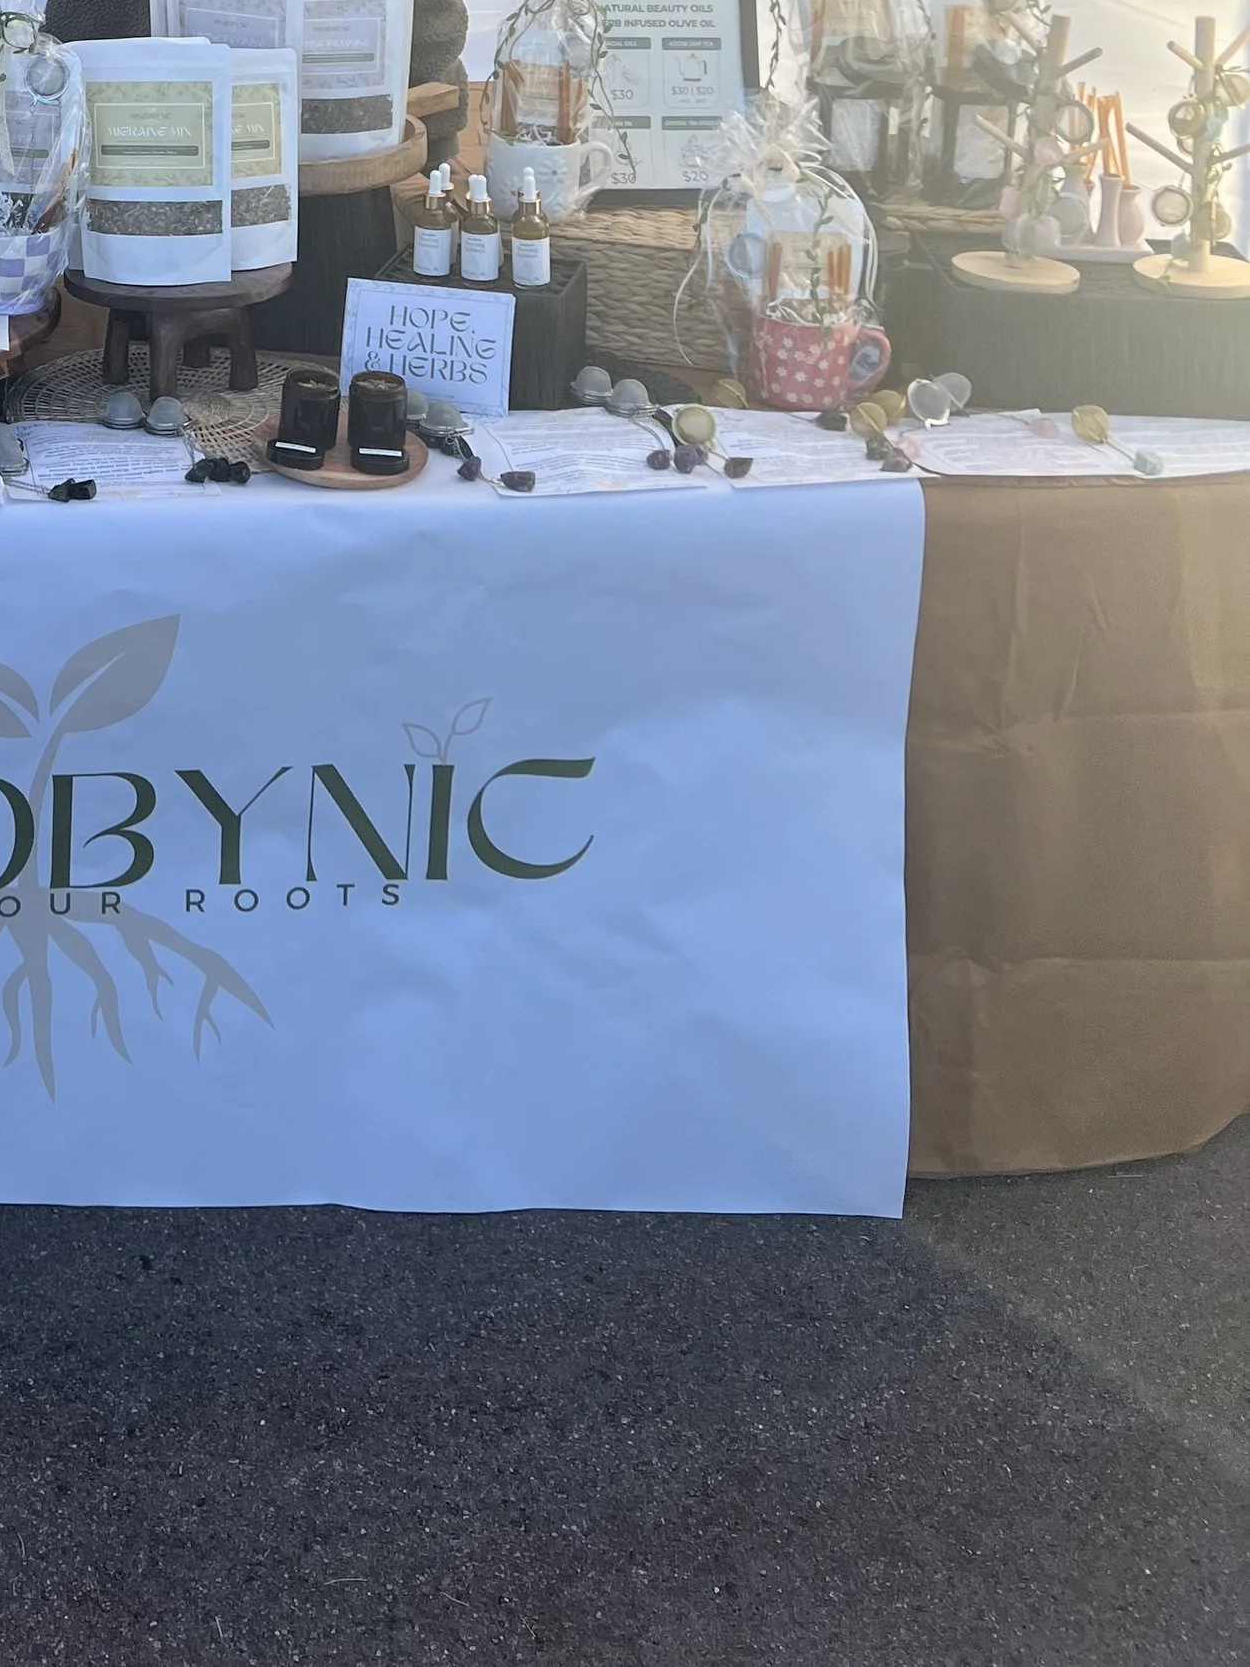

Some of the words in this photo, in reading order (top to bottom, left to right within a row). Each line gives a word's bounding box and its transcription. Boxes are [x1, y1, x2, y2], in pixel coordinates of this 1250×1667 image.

[647, 4, 688, 13] BEAUTY
[691, 4, 713, 13] OILS
[624, 19, 667, 28] INFUSED
[668, 19, 697, 27] OLIVE
[699, 19, 716, 28] OIL
[611, 89, 634, 100] $30
[671, 86, 689, 96] $30
[696, 86, 714, 96] $20
[107, 126, 166, 138] MIGRAINE
[171, 126, 192, 138] MIX
[611, 172, 636, 184] $30
[682, 170, 709, 182] $20
[365, 327, 497, 360] HEALING
[364, 350, 381, 372] &
[388, 353, 488, 384] HERBS
[184, 882, 402, 914] ROOTS
